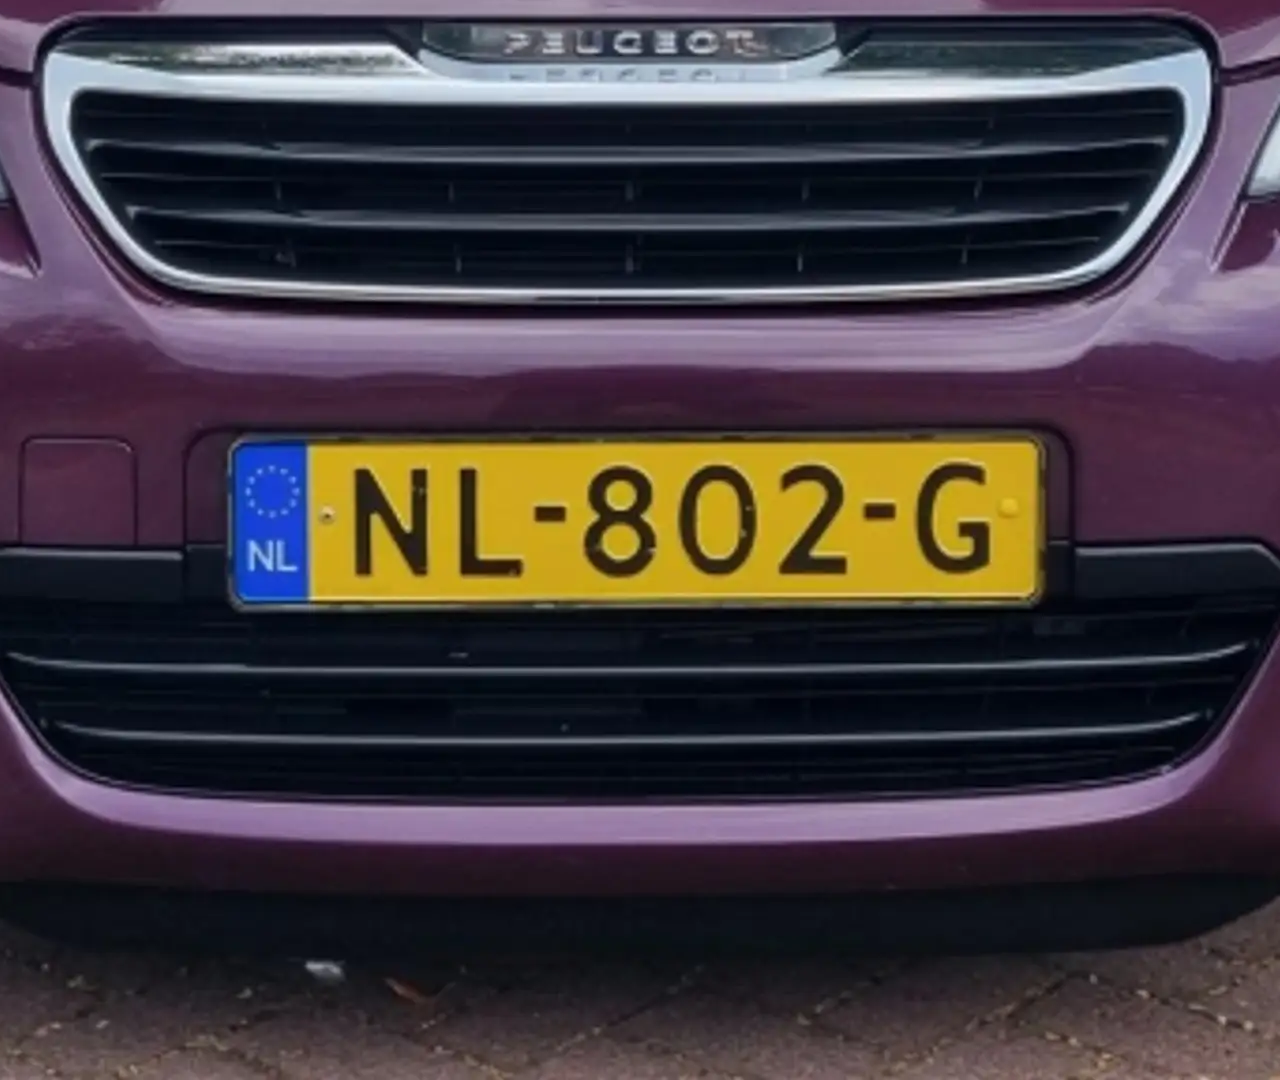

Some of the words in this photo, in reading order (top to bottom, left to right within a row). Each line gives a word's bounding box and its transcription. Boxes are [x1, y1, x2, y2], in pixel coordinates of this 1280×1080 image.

[503, 29, 762, 56] PEUGEOT
[353, 463, 993, 580] NL-802-G
[246, 539, 298, 573] NL
